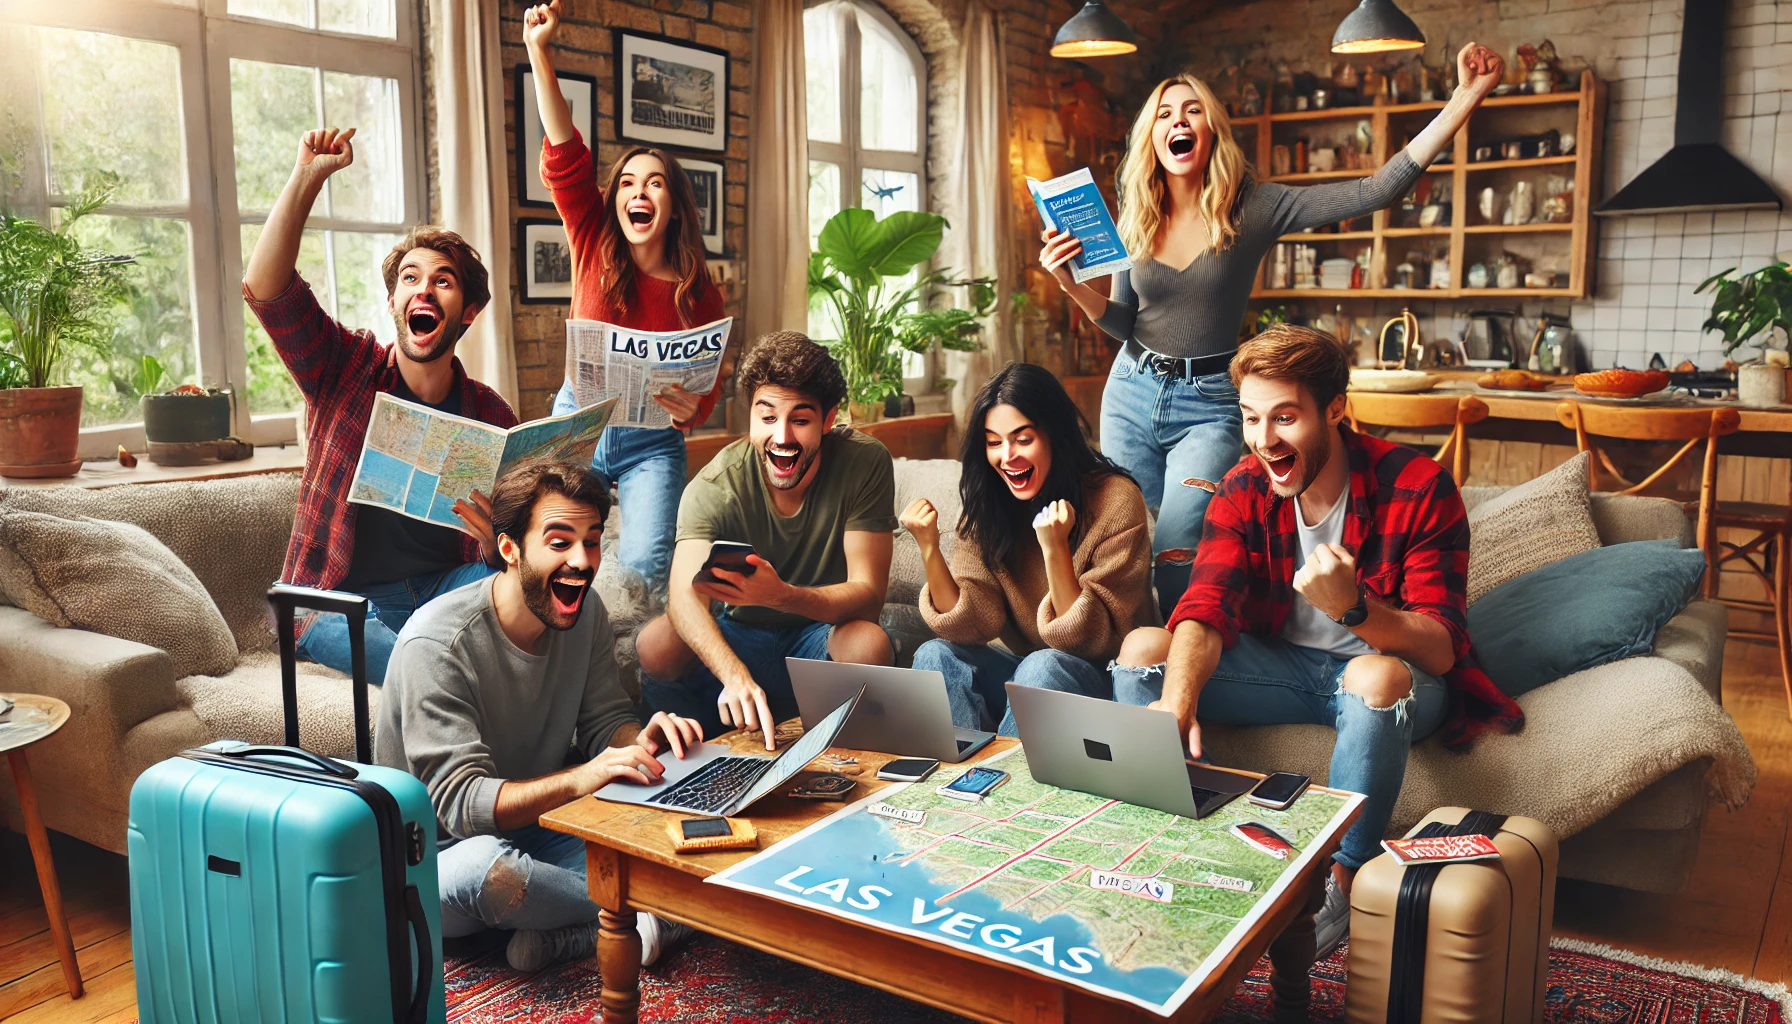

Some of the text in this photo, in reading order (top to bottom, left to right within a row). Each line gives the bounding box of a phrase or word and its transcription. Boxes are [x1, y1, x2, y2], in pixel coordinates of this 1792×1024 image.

[611, 332, 723, 361] LAS VEGAS
[774, 865, 1100, 974] LAS VEGAS
